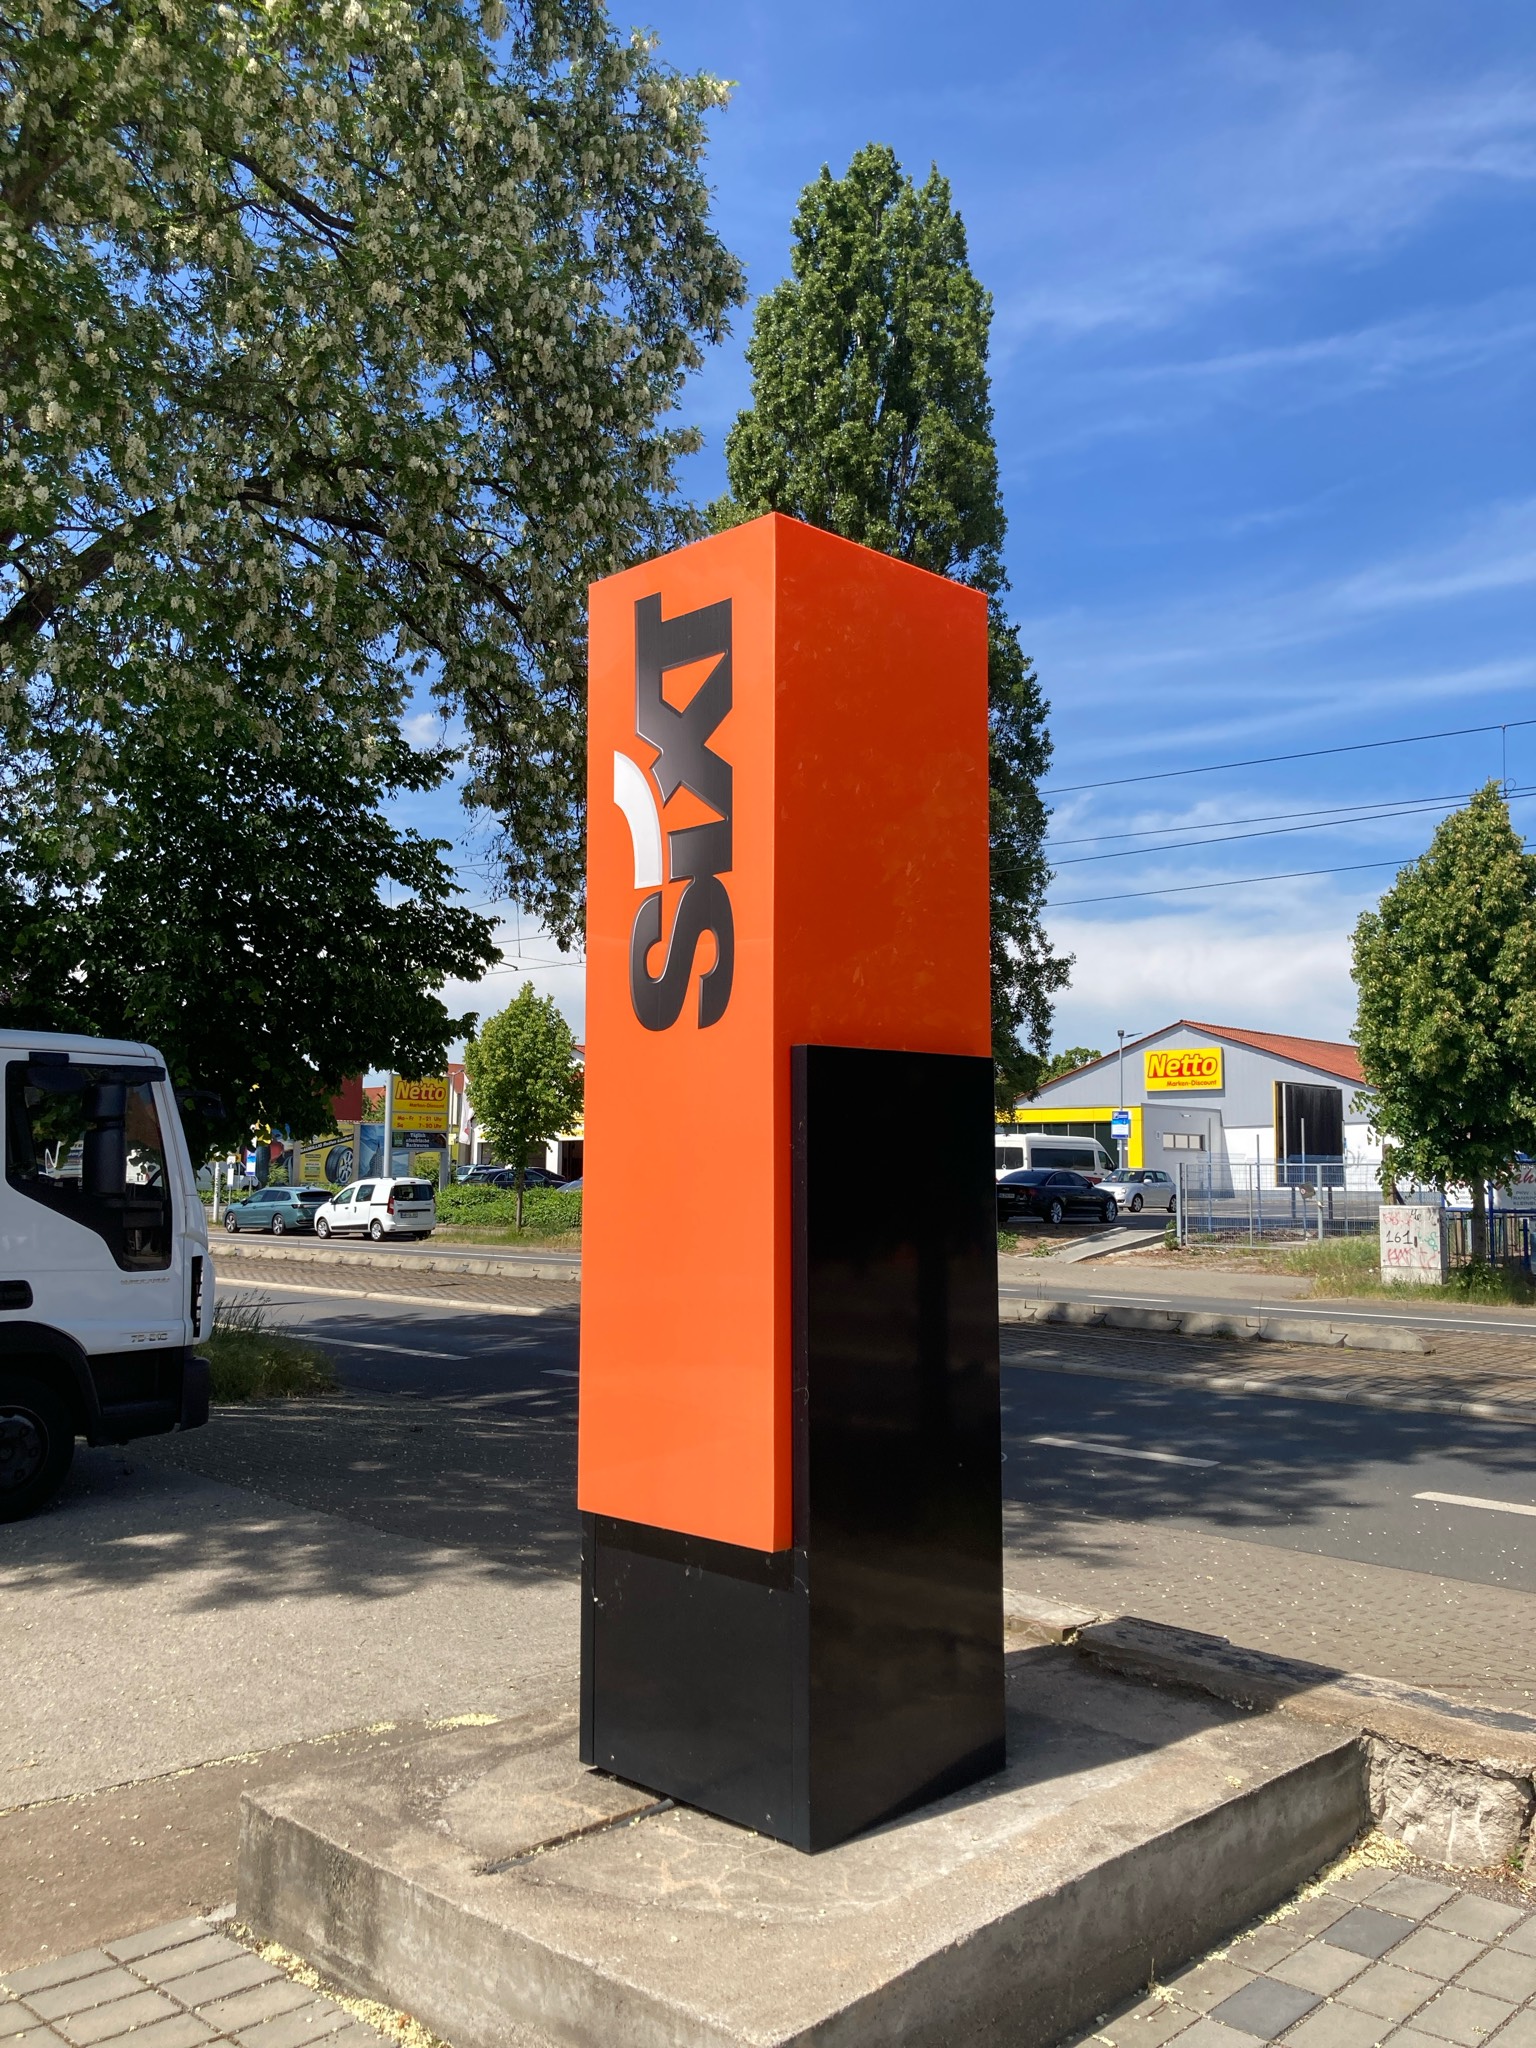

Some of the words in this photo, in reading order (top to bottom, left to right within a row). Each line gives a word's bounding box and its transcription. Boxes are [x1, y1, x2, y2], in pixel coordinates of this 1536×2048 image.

[614, 592, 735, 1032] SIXT
[1147, 1053, 1218, 1078] Netto
[395, 1081, 446, 1101] Netto
[1386, 1230, 1413, 1245] 161
